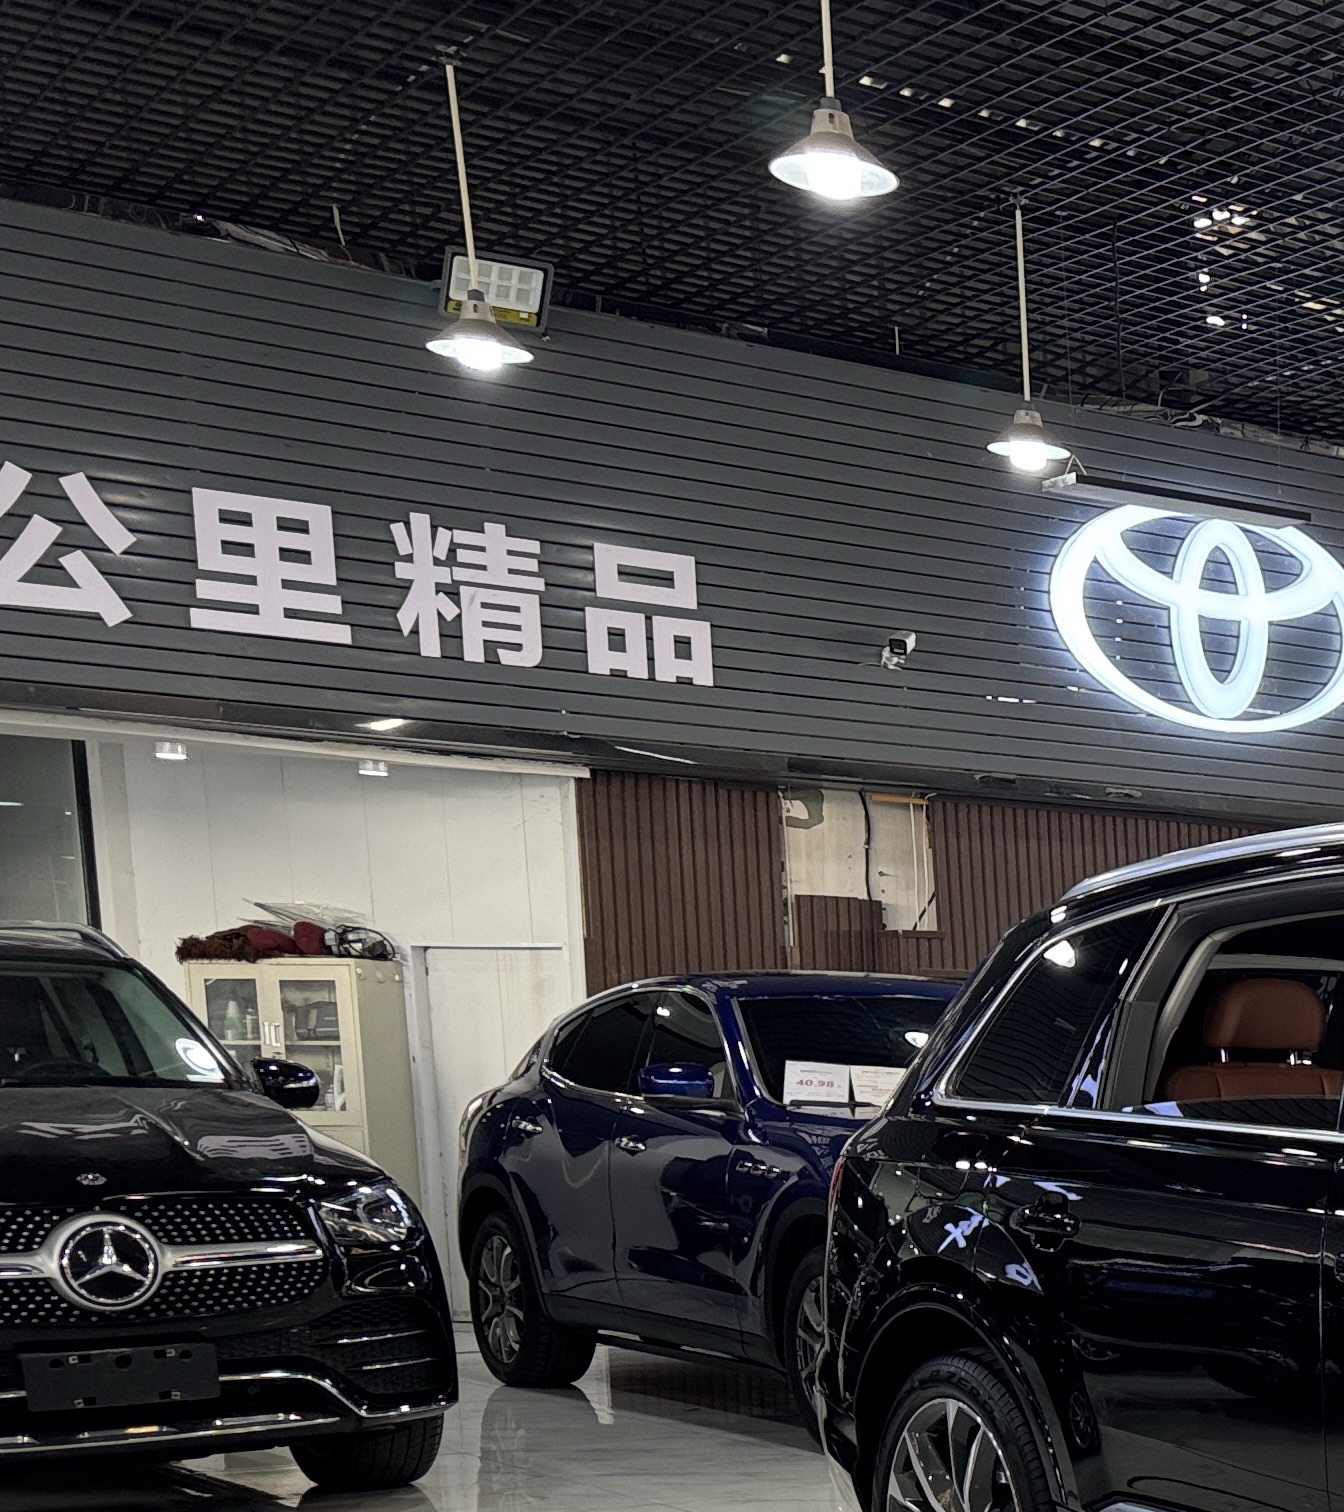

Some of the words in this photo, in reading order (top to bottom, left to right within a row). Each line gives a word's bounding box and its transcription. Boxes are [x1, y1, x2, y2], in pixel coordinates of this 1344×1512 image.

[0, 460, 715, 686] 公里精品
[796, 1079, 834, 1088] 40.98
